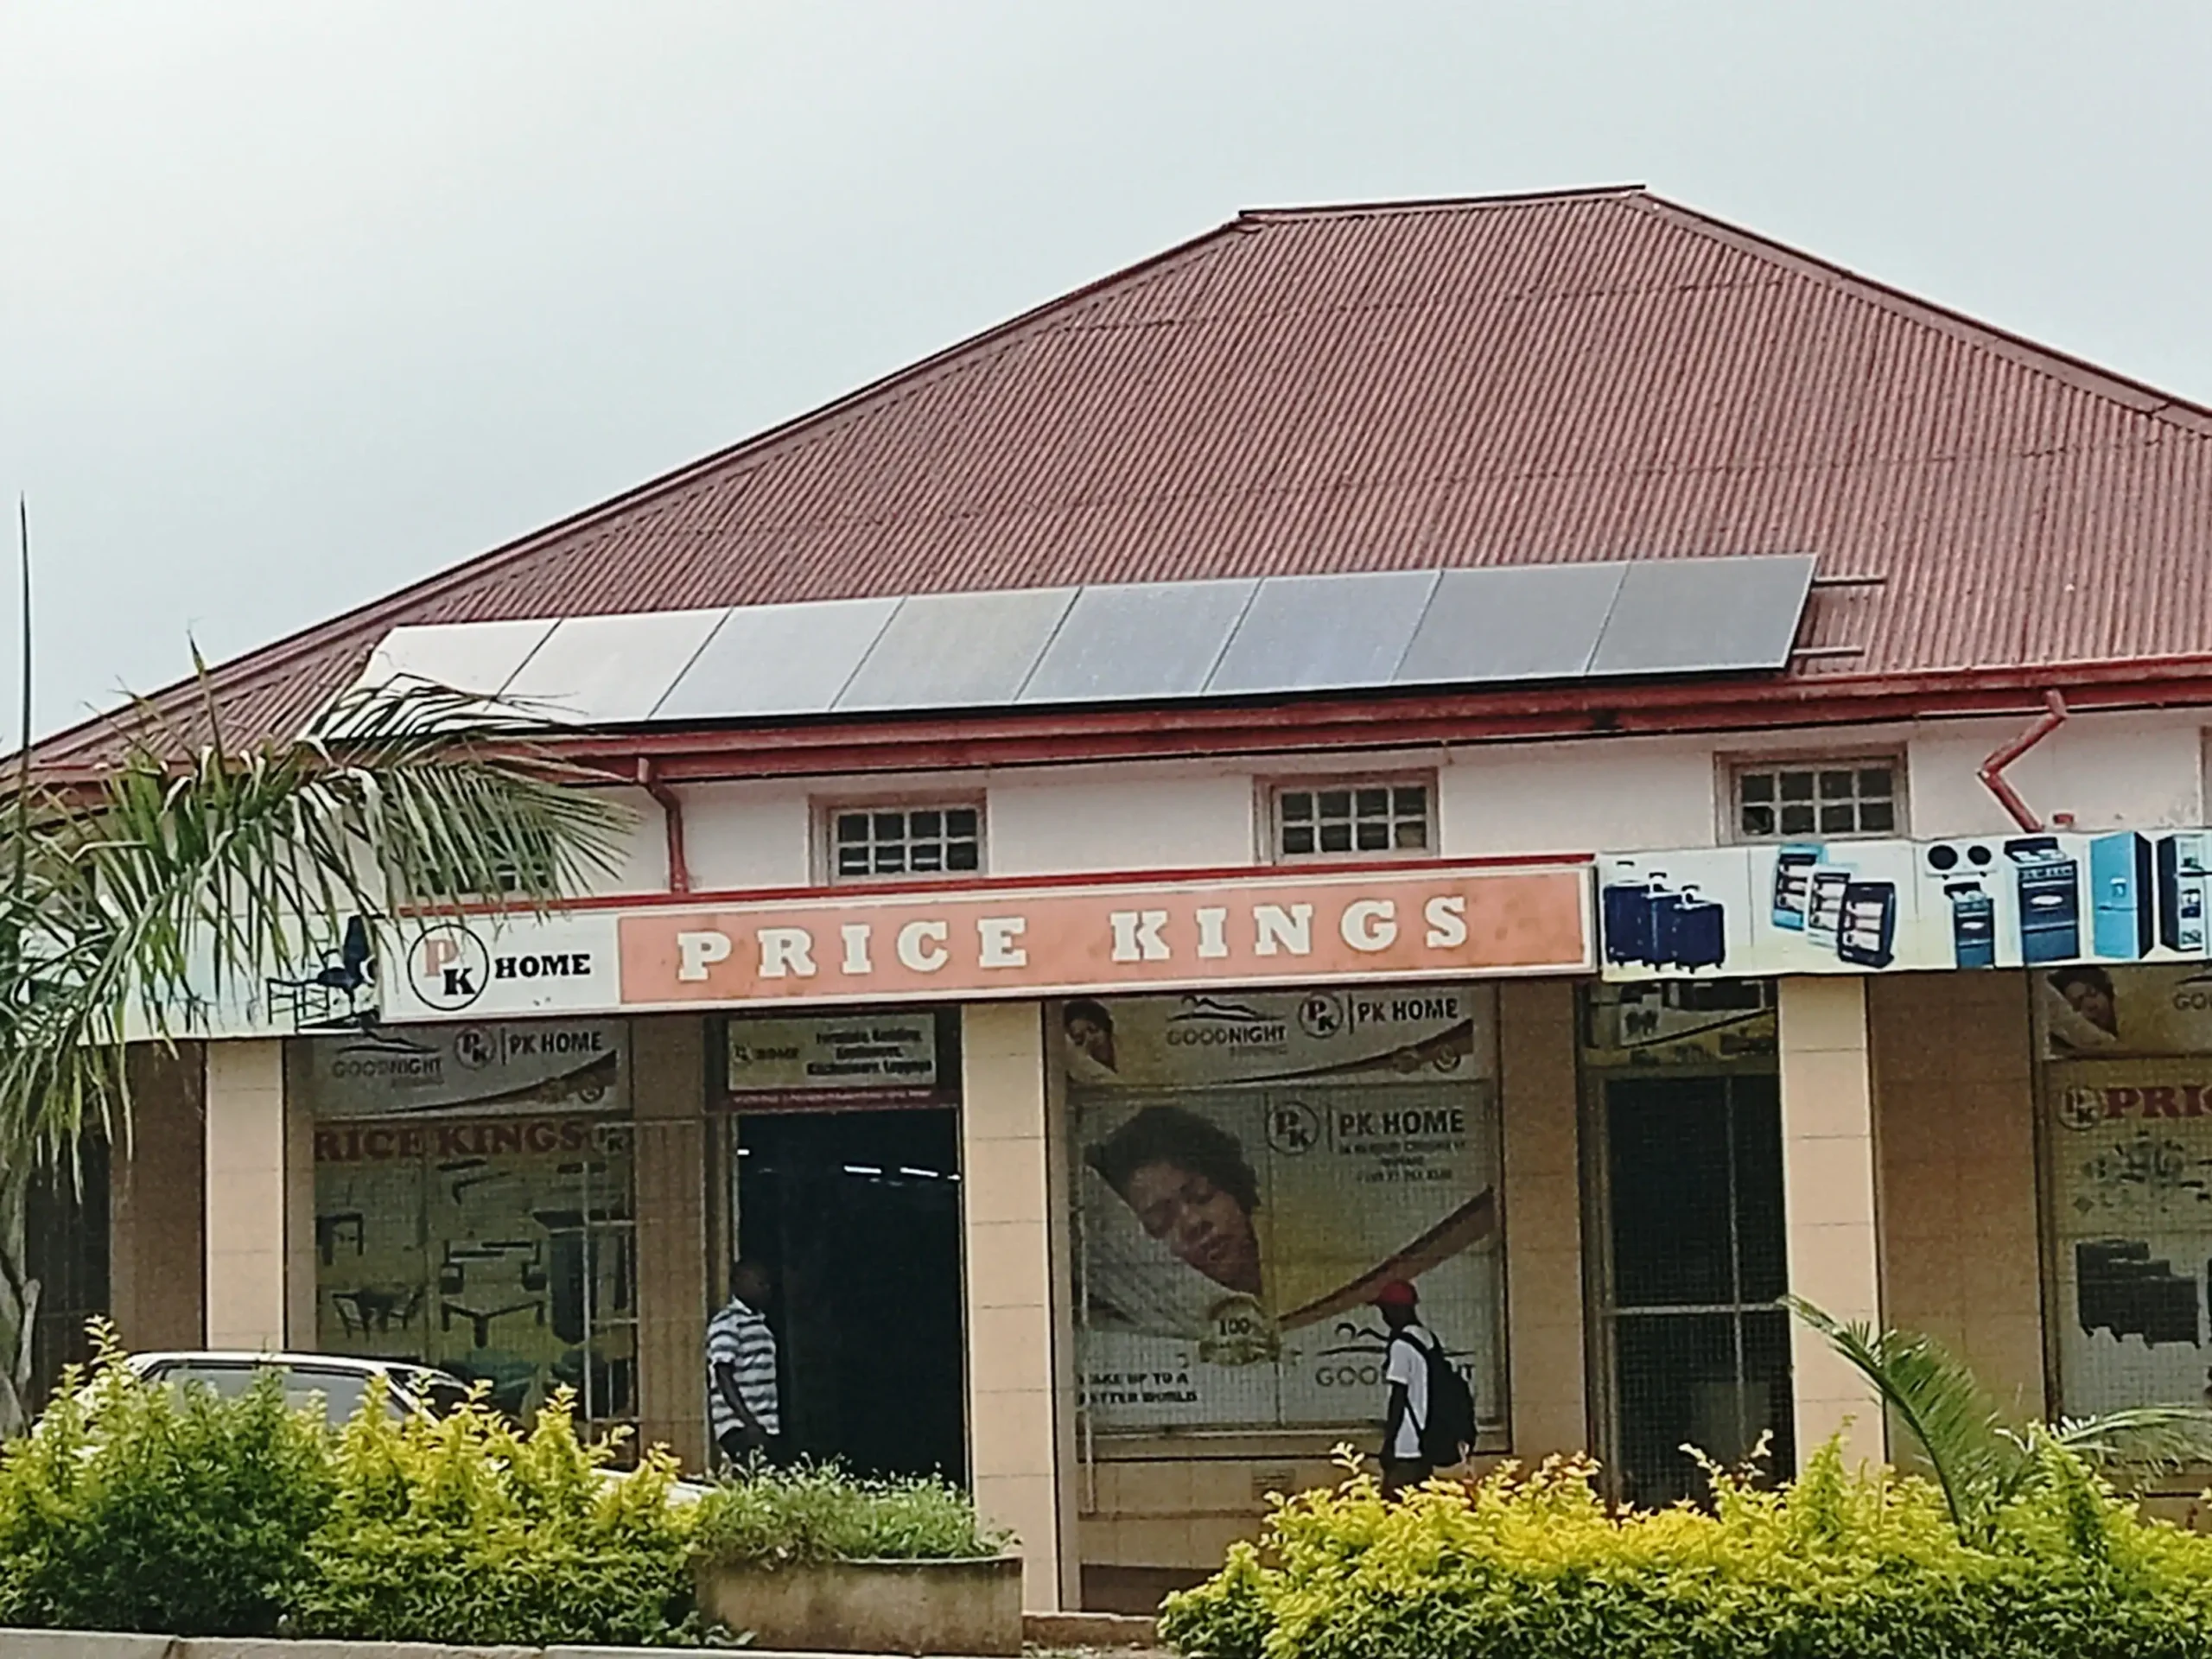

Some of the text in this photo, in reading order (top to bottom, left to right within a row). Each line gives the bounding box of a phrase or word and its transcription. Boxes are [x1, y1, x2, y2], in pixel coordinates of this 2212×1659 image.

[677, 895, 1468, 982] PRICE KINGS
[495, 953, 591, 979] HOME
[1359, 1002, 1387, 1023] PK
[1393, 998, 1459, 1021] HOME
[510, 1036, 537, 1055] PK
[541, 1031, 602, 1053] HOME
[1339, 1113, 1375, 1136] PK
[1383, 1109, 1465, 1135] HOME
[436, 1121, 586, 1156] KINGS
